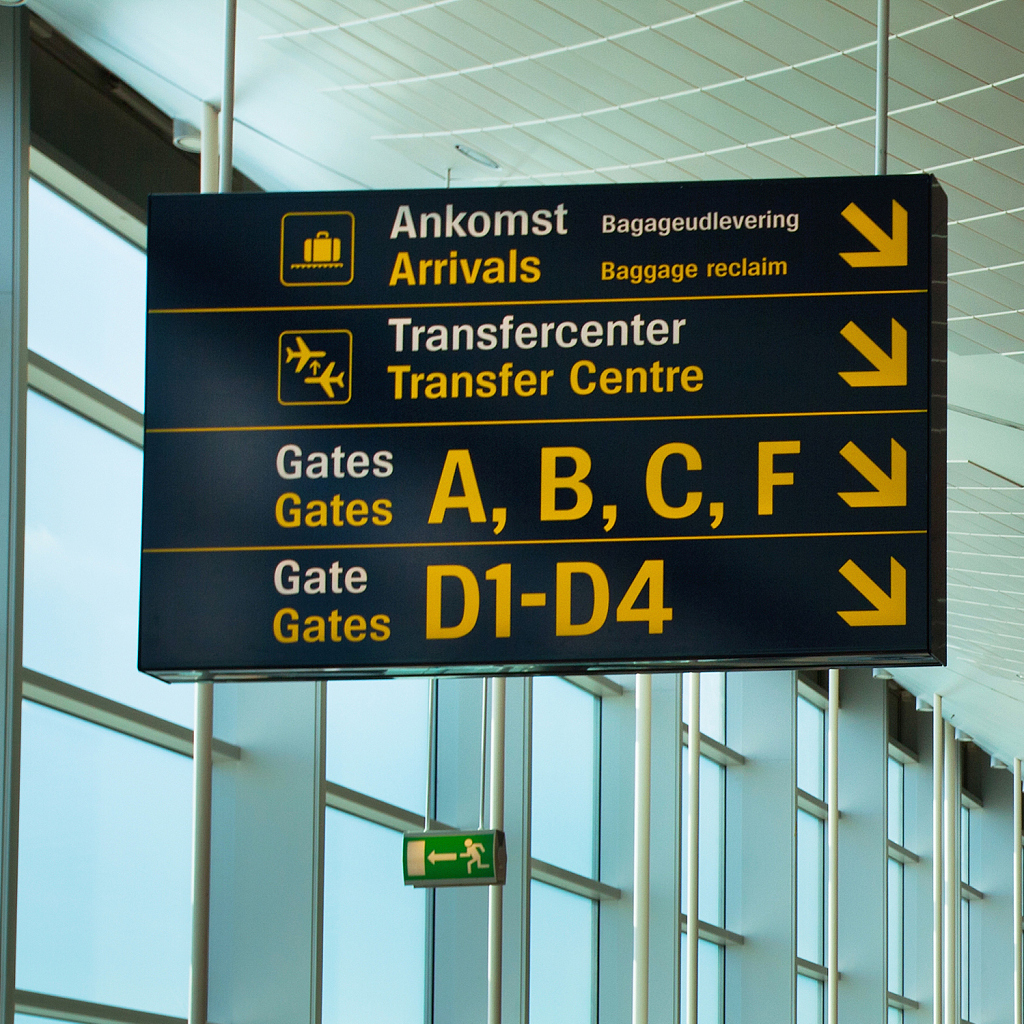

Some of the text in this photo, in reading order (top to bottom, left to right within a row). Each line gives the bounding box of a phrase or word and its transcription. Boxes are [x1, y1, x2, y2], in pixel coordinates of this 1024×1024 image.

[389, 203, 568, 240] Ankomst
[602, 210, 799, 237] Bagageudlevering
[388, 248, 542, 287] Arrivals
[601, 257, 788, 285] Baggage reclaim
[387, 313, 687, 352] Transfercenter
[386, 359, 704, 400] Transfer Centre
[275, 443, 394, 480] Gates
[427, 440, 801, 536] A, B, C, F
[274, 491, 393, 529] Gates
[273, 559, 368, 596] Gate
[425, 559, 673, 640] D1-D4
[272, 607, 391, 644] Gates
